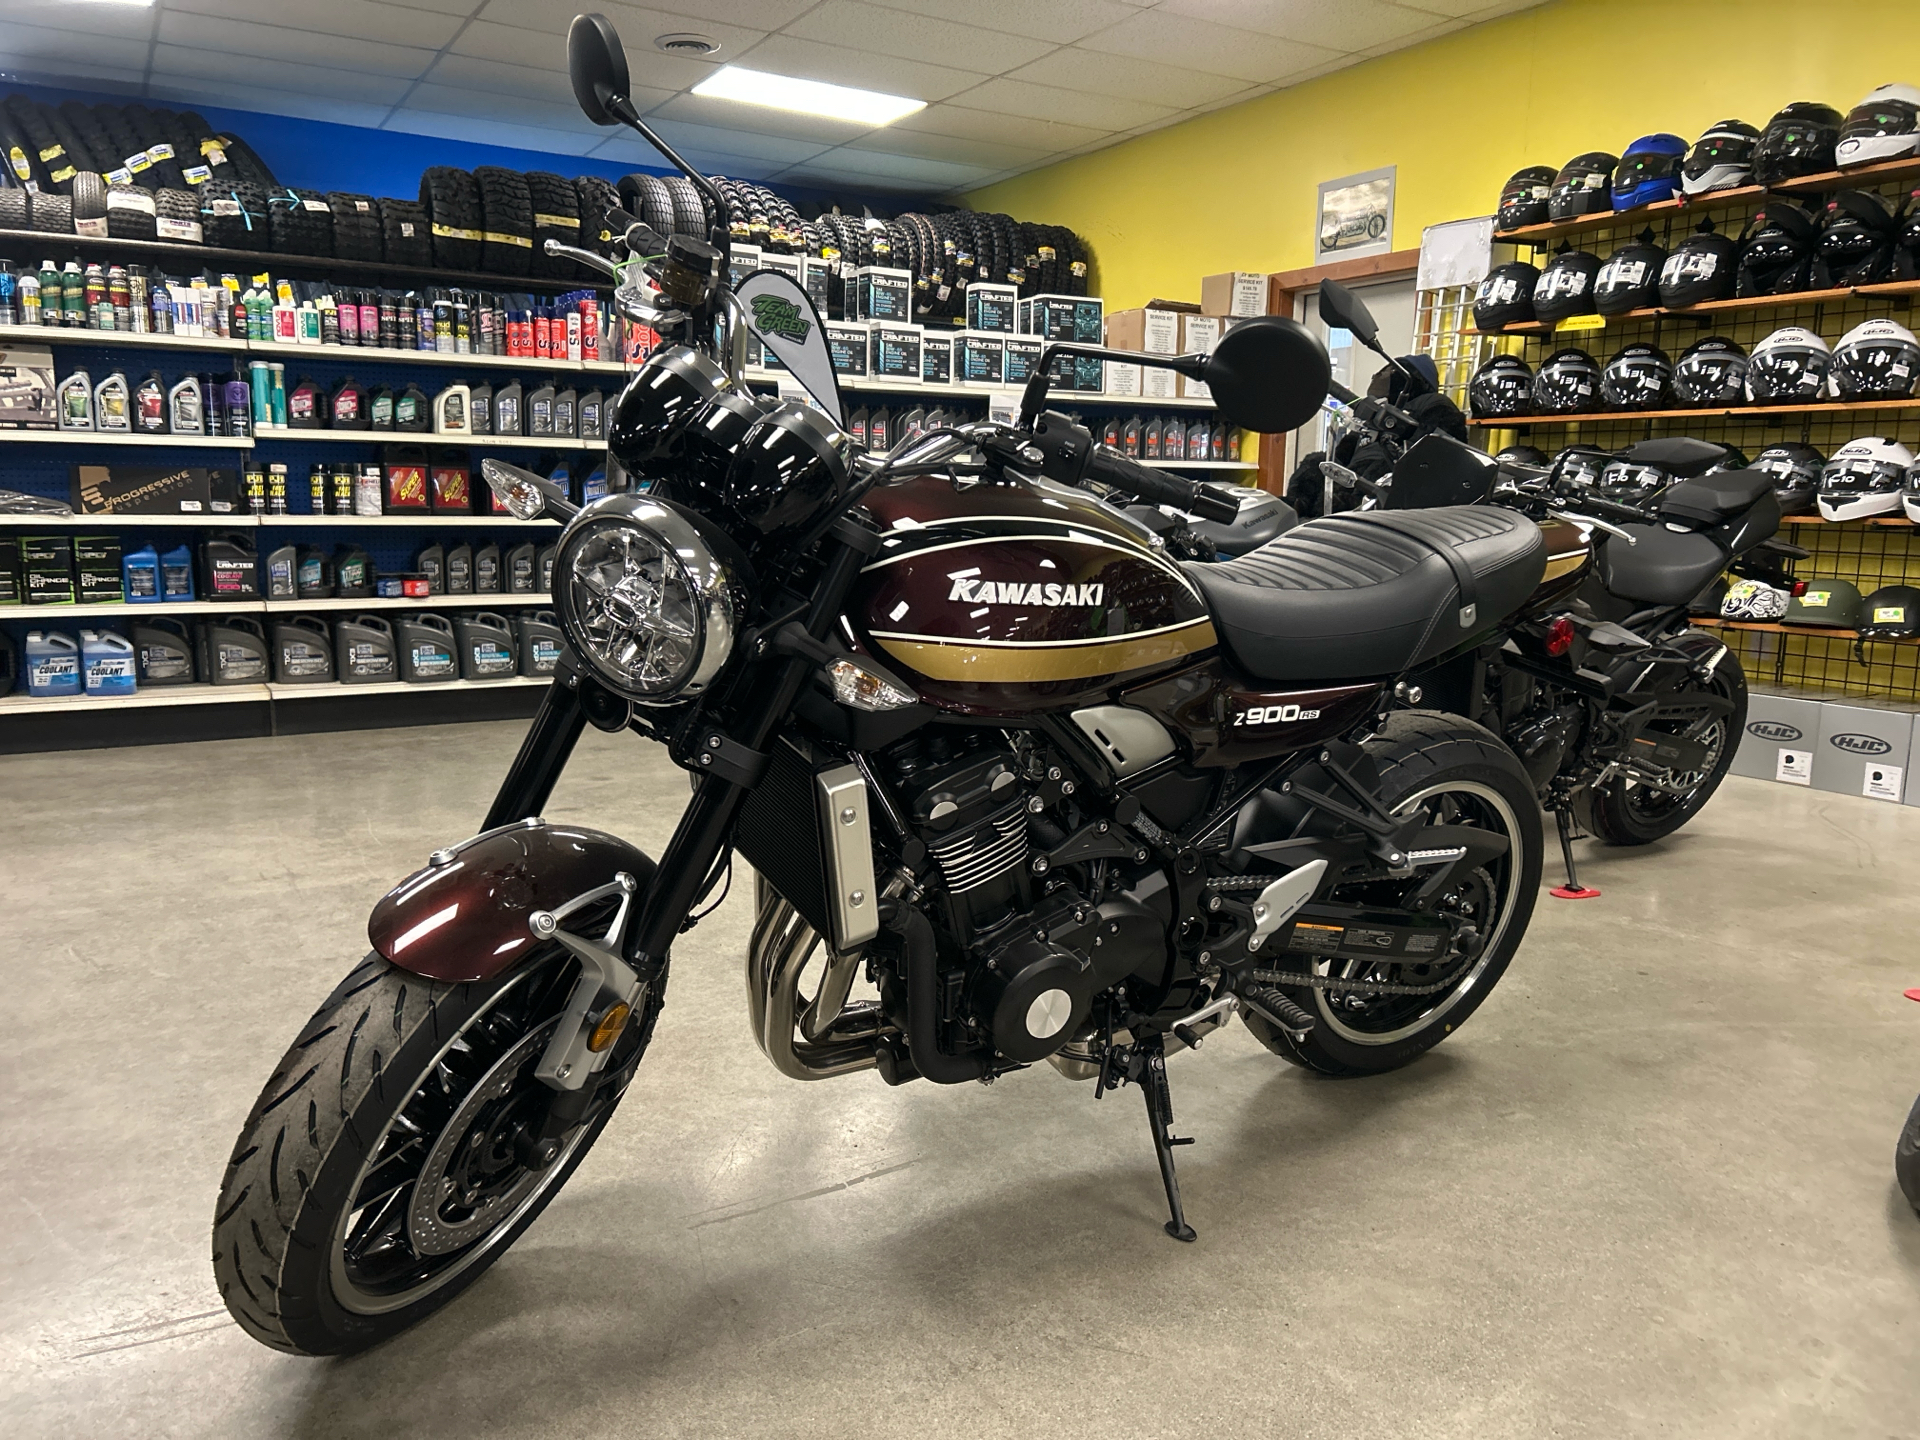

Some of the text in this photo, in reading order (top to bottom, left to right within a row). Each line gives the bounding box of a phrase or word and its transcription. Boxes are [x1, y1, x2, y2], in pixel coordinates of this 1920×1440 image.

[731, 257, 757, 266] AFTED
[872, 278, 907, 288] CRAFTED
[980, 294, 1013, 302] CRAFTED
[752, 295, 800, 319] TEAM
[757, 314, 808, 334] GREEN
[828, 333, 865, 342] CRAFTED
[882, 333, 919, 343] CRAFTED
[967, 341, 1001, 350] CRAFTED
[1007, 344, 1040, 352] CRAFTED
[104, 469, 190, 510] PROGRESSIVE
[401, 471, 419, 500] SUPER
[948, 579, 1104, 606] KAWASAKI
[39, 665, 73, 674] COOLANT
[90, 667, 124, 676] COOLANT
[1300, 710, 1320, 720] RS
[1753, 724, 1795, 738] HJC
[1838, 736, 1884, 751] HJC
